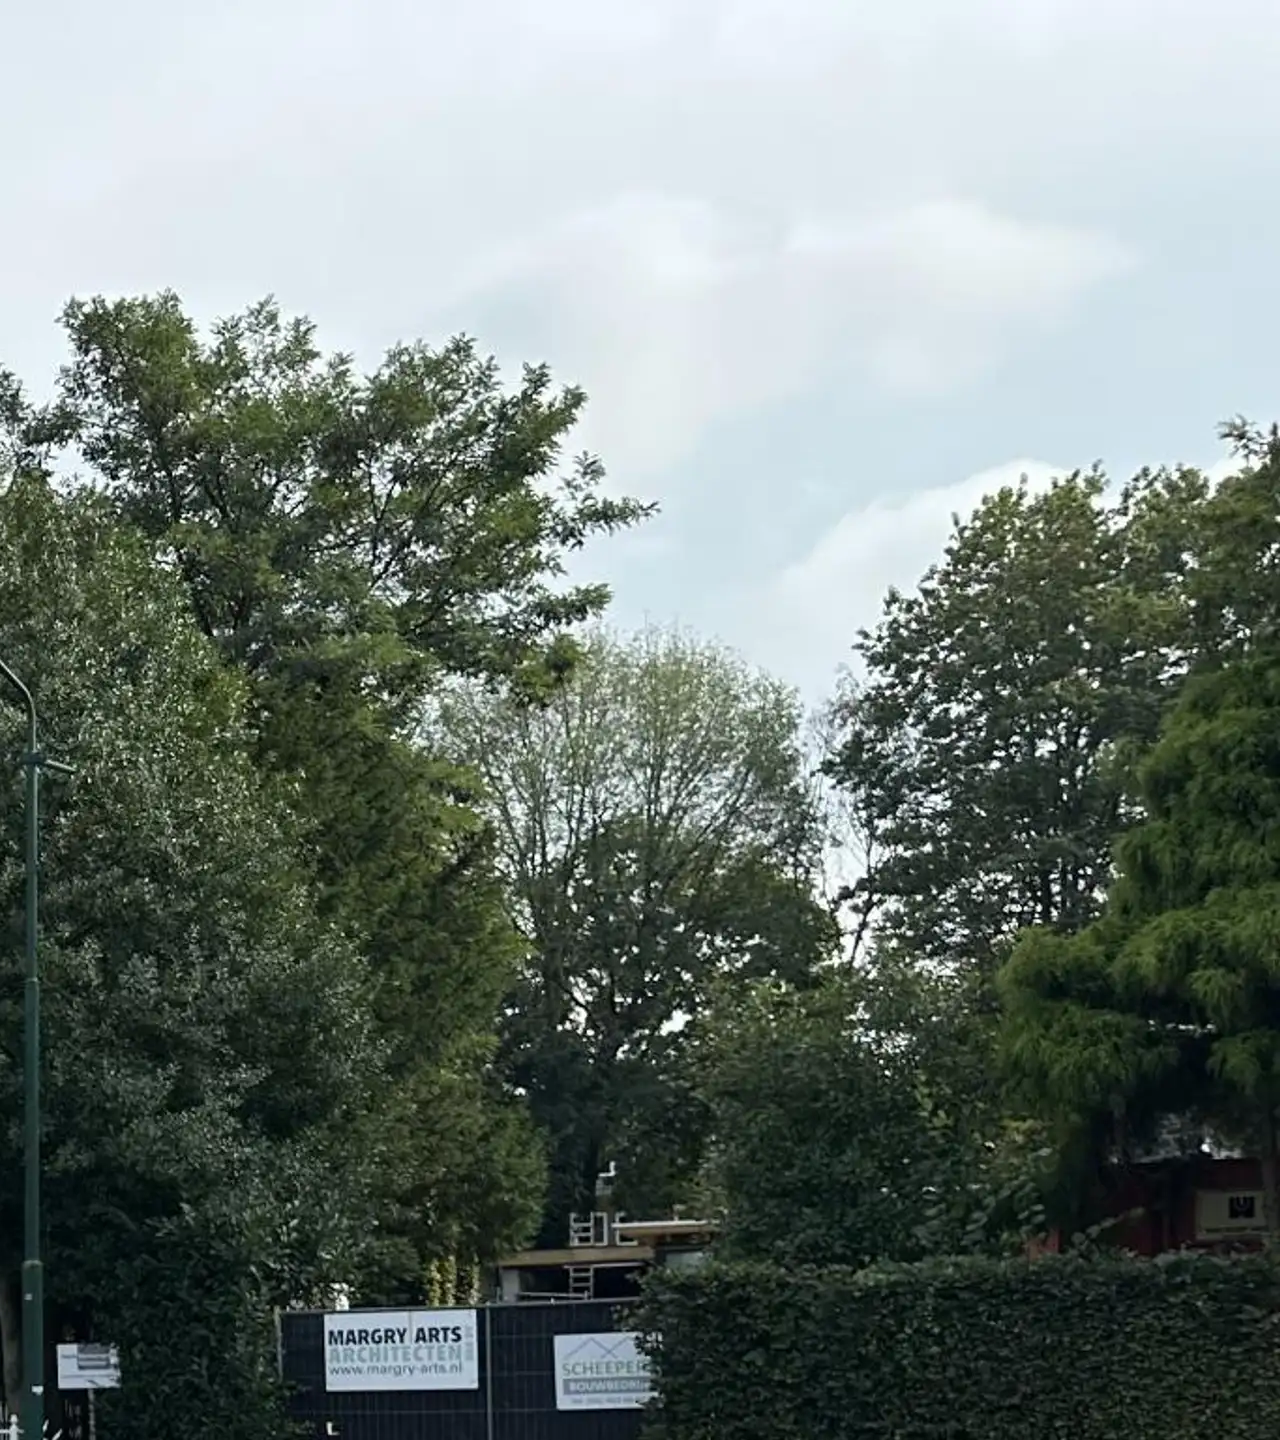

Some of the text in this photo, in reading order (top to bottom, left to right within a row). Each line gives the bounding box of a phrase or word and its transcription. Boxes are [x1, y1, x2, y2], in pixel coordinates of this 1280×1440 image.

[328, 1327, 407, 1346] MARGRY
[414, 1326, 462, 1344] ARTS
[329, 1345, 462, 1363] ARCHITECTEN
[329, 1362, 462, 1377] www.margry-arts.nl
